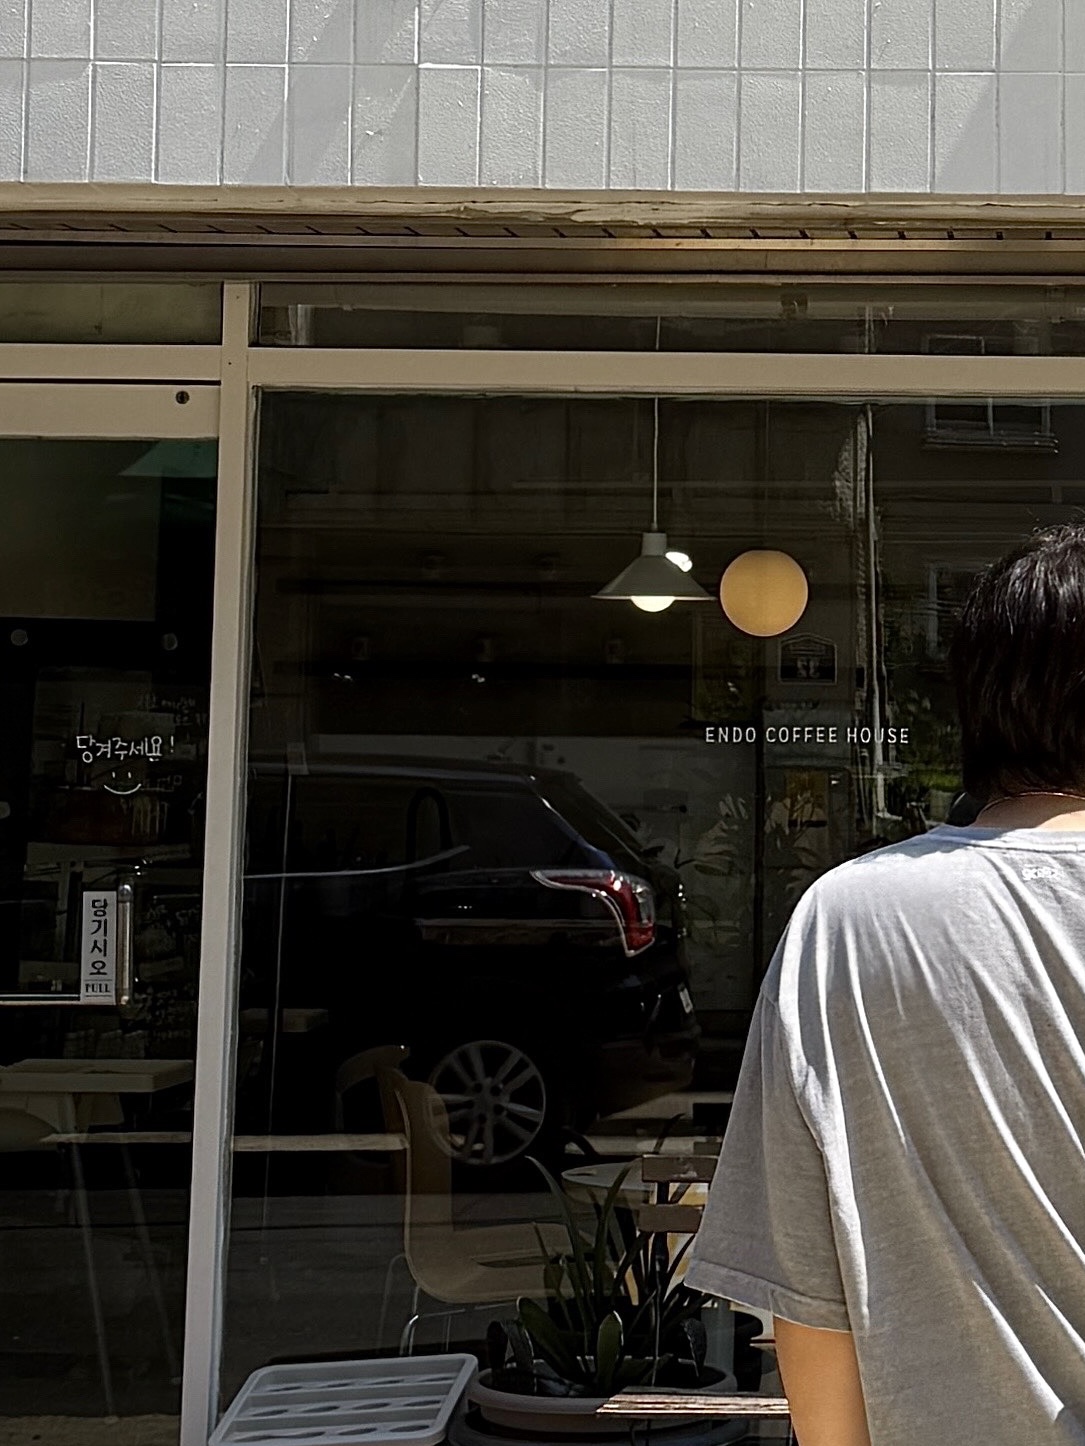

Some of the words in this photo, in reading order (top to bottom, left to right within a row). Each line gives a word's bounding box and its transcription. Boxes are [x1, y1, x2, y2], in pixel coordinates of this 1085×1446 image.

[705, 726, 757, 743] ENDO
[765, 726, 838, 743] COFFEE
[846, 726, 910, 744] HOUSE
[89, 898, 109, 976] 당기시오
[85, 982, 111, 993] PULL
